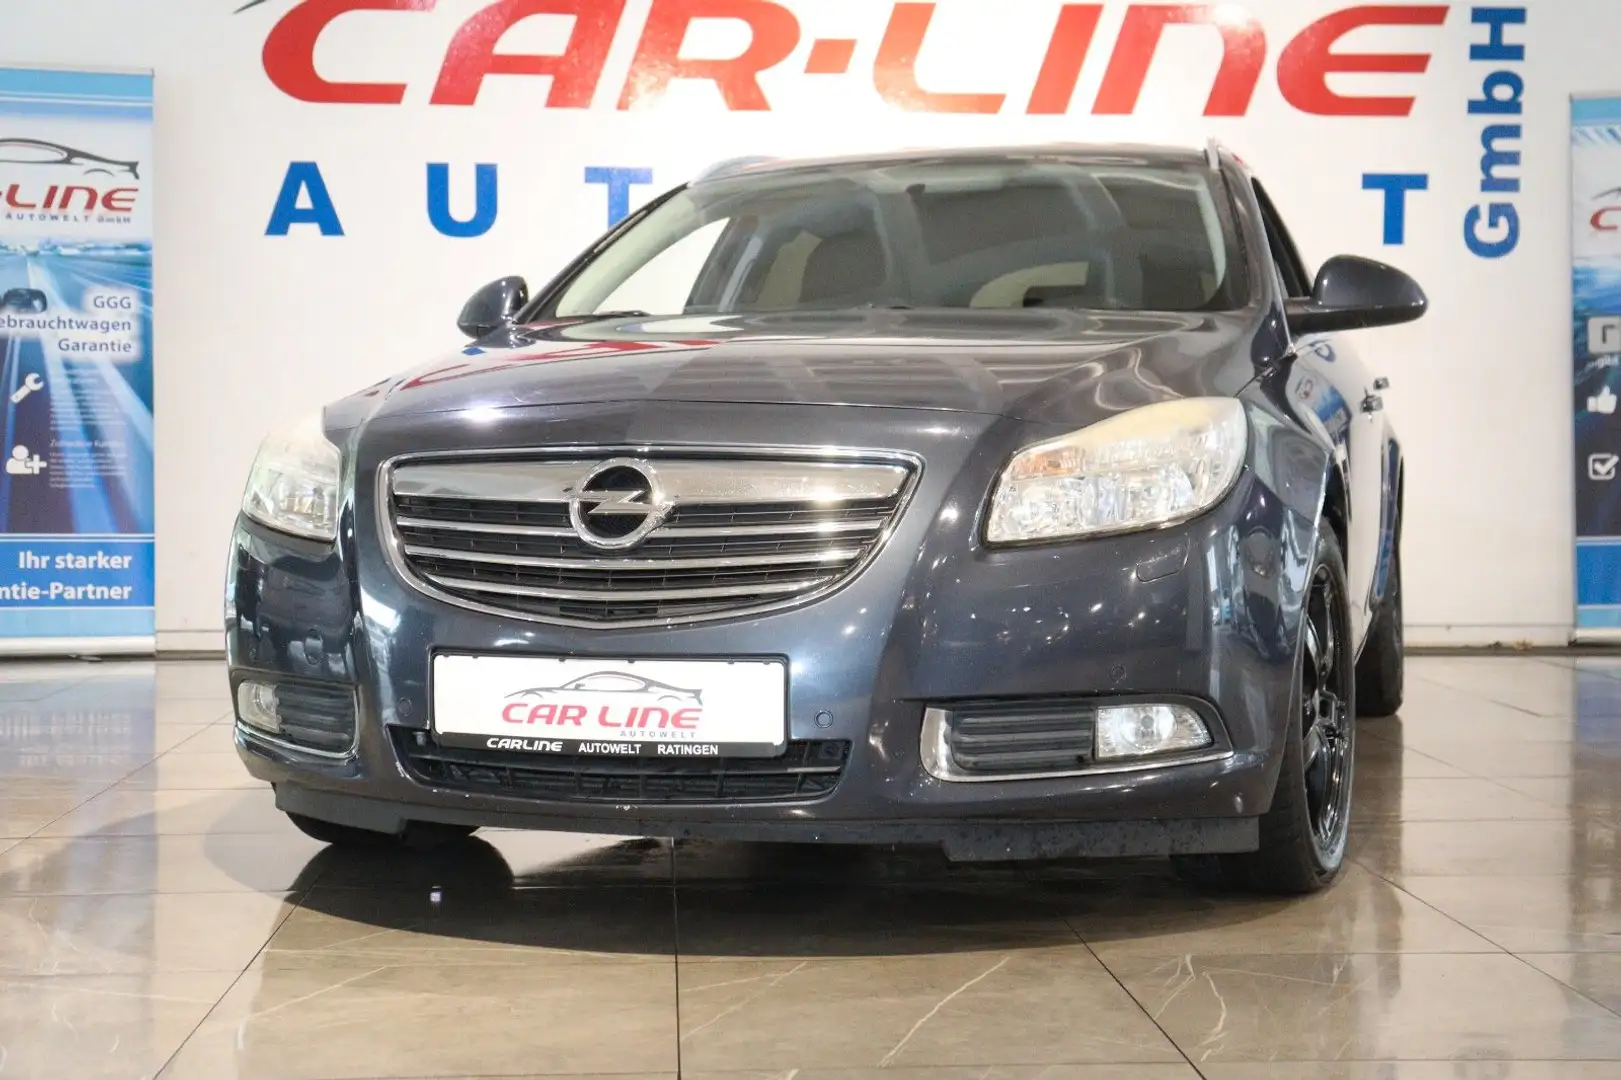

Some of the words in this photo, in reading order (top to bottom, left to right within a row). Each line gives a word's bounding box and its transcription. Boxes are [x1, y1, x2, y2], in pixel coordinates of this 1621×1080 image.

[262, 0, 1447, 116] CAR-LINE
[1464, 6, 1527, 259] GmbH
[0, 184, 139, 212] LINE
[5, 212, 90, 223] AUTOWELT
[93, 295, 132, 309] GGG
[58, 338, 132, 353] Garantie
[19, 550, 51, 569] Ihr
[54, 550, 132, 569] starker
[0, 581, 132, 600] ntie-Partner
[502, 702, 588, 726] CAR
[597, 706, 703, 729] LINE
[619, 730, 697, 739] AUTOWELT
[486, 737, 563, 752] CARLINE
[578, 742, 642, 755] AUTOWELT
[657, 744, 719, 755] RATINGEN
